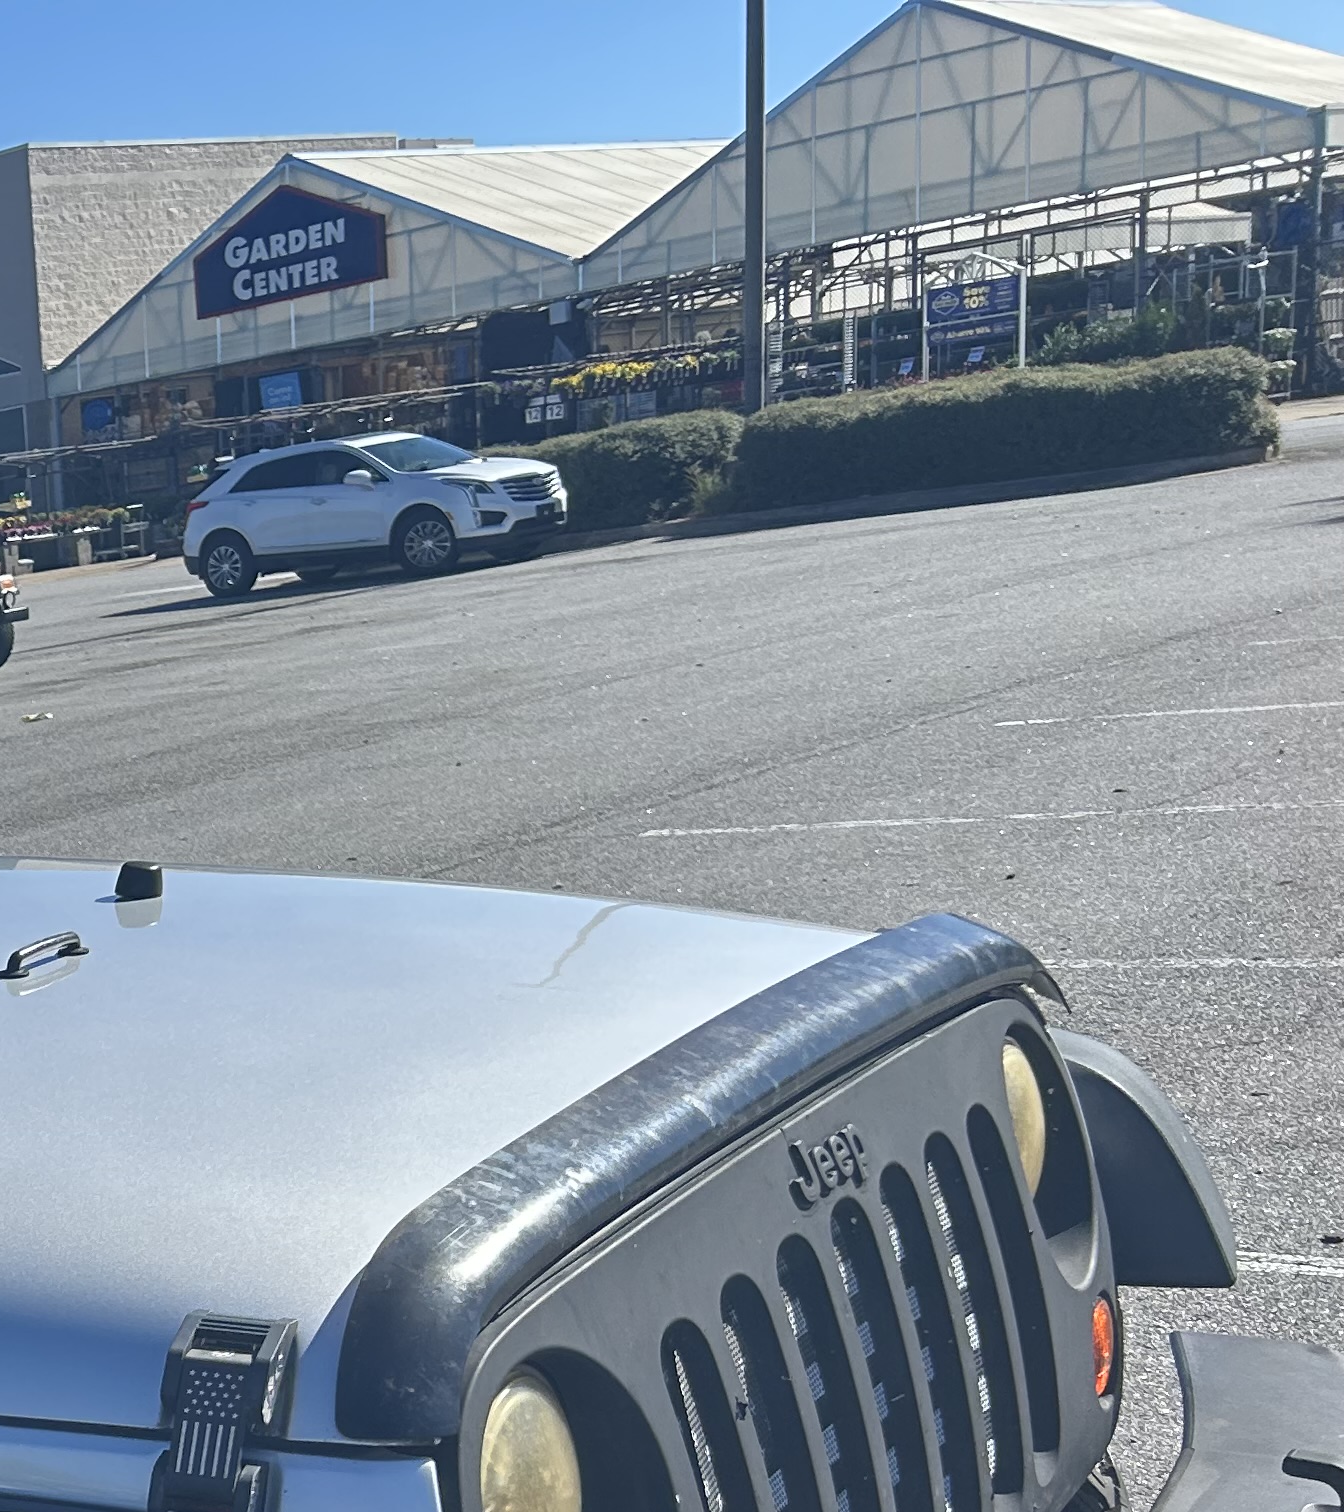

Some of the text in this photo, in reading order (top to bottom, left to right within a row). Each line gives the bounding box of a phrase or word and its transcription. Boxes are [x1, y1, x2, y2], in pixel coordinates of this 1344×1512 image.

[224, 217, 346, 269] GARDEN
[232, 256, 340, 301] CENTER
[788, 1123, 869, 1212] Jeep
